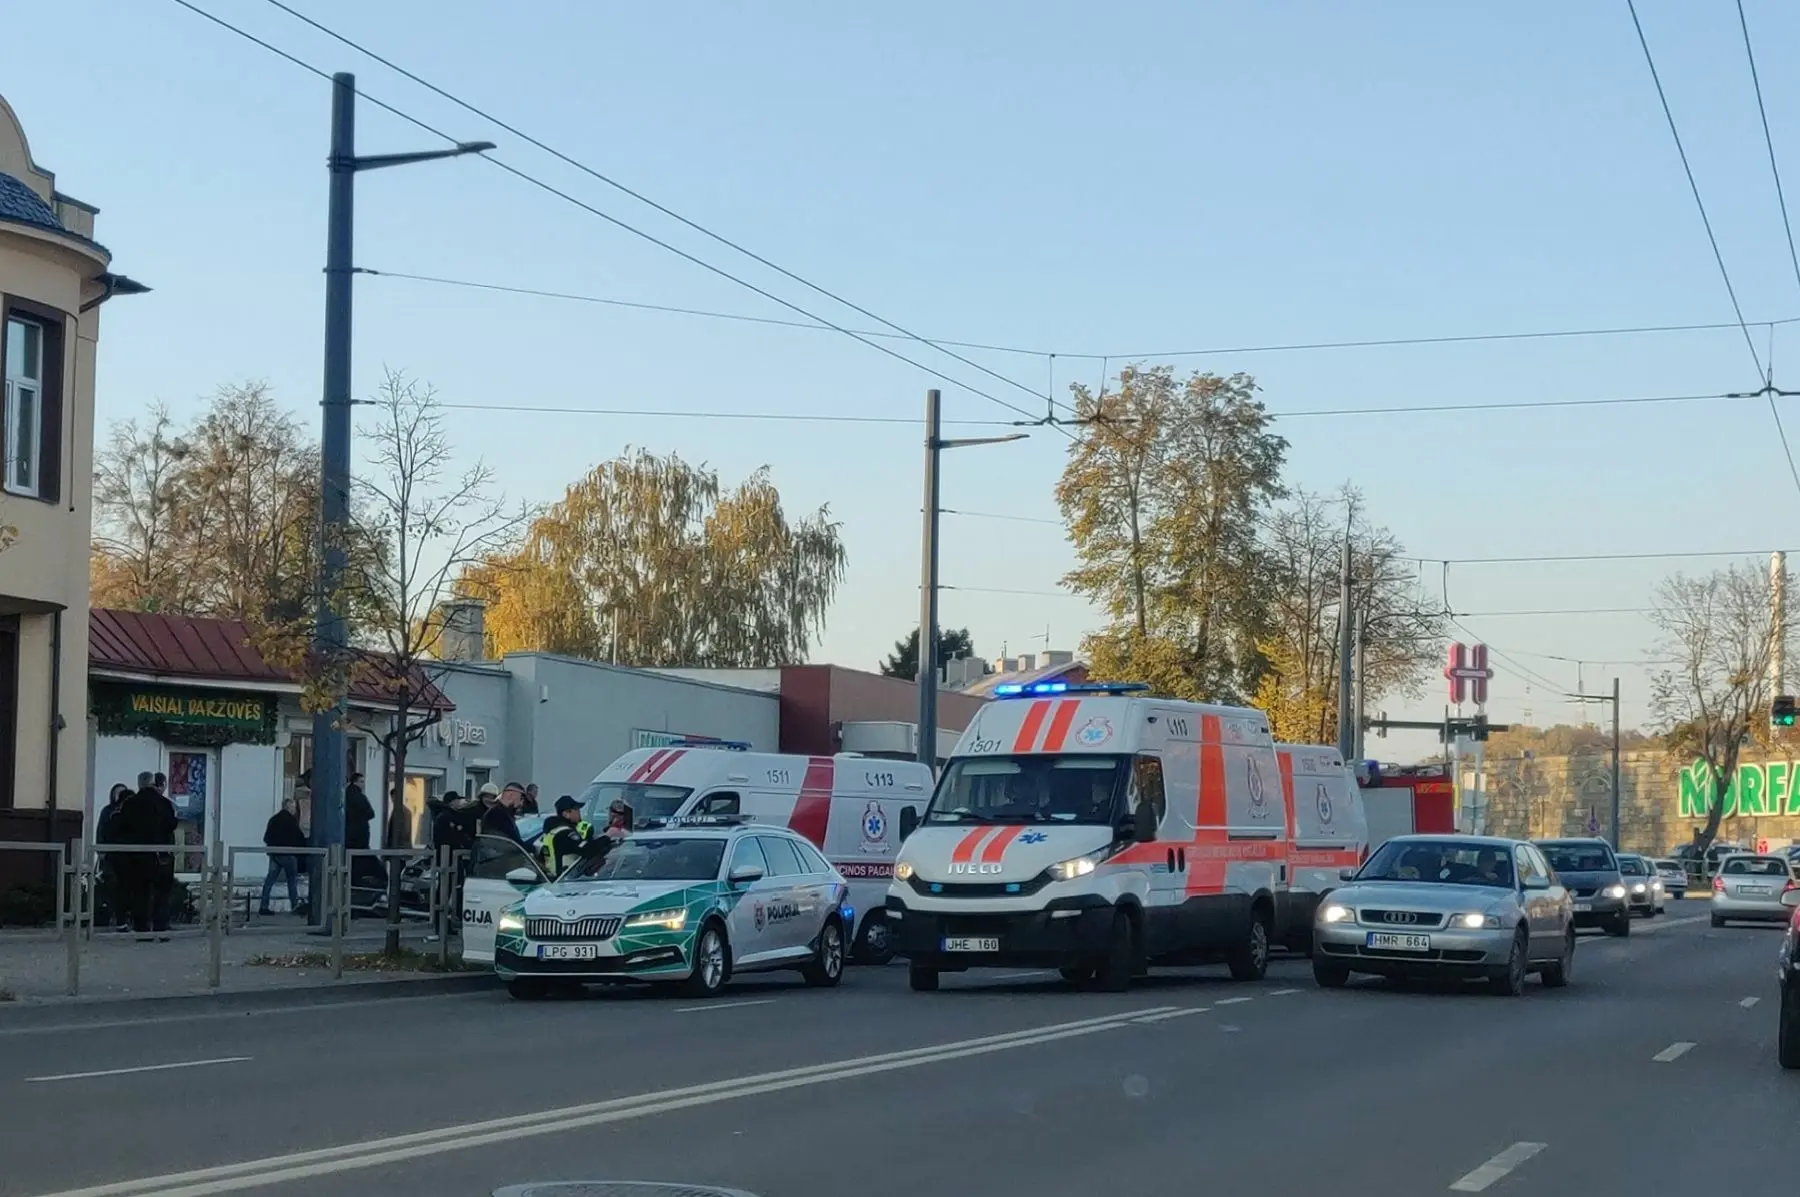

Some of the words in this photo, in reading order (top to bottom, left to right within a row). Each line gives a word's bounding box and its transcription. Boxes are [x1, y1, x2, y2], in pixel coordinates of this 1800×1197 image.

[131, 694, 185, 716] VAISIAI,
[967, 739, 1002, 753] 1501
[766, 769, 790, 784] 1511
[874, 773, 894, 787] 113
[947, 863, 1003, 875] IVECO
[463, 909, 493, 924] CIJA
[767, 903, 800, 920] POLICIJA
[947, 939, 970, 950] JHE
[1375, 934, 1399, 945] HMR
[1406, 936, 1427, 947] 664
[544, 946, 567, 957] LPG
[574, 946, 594, 957] 931
